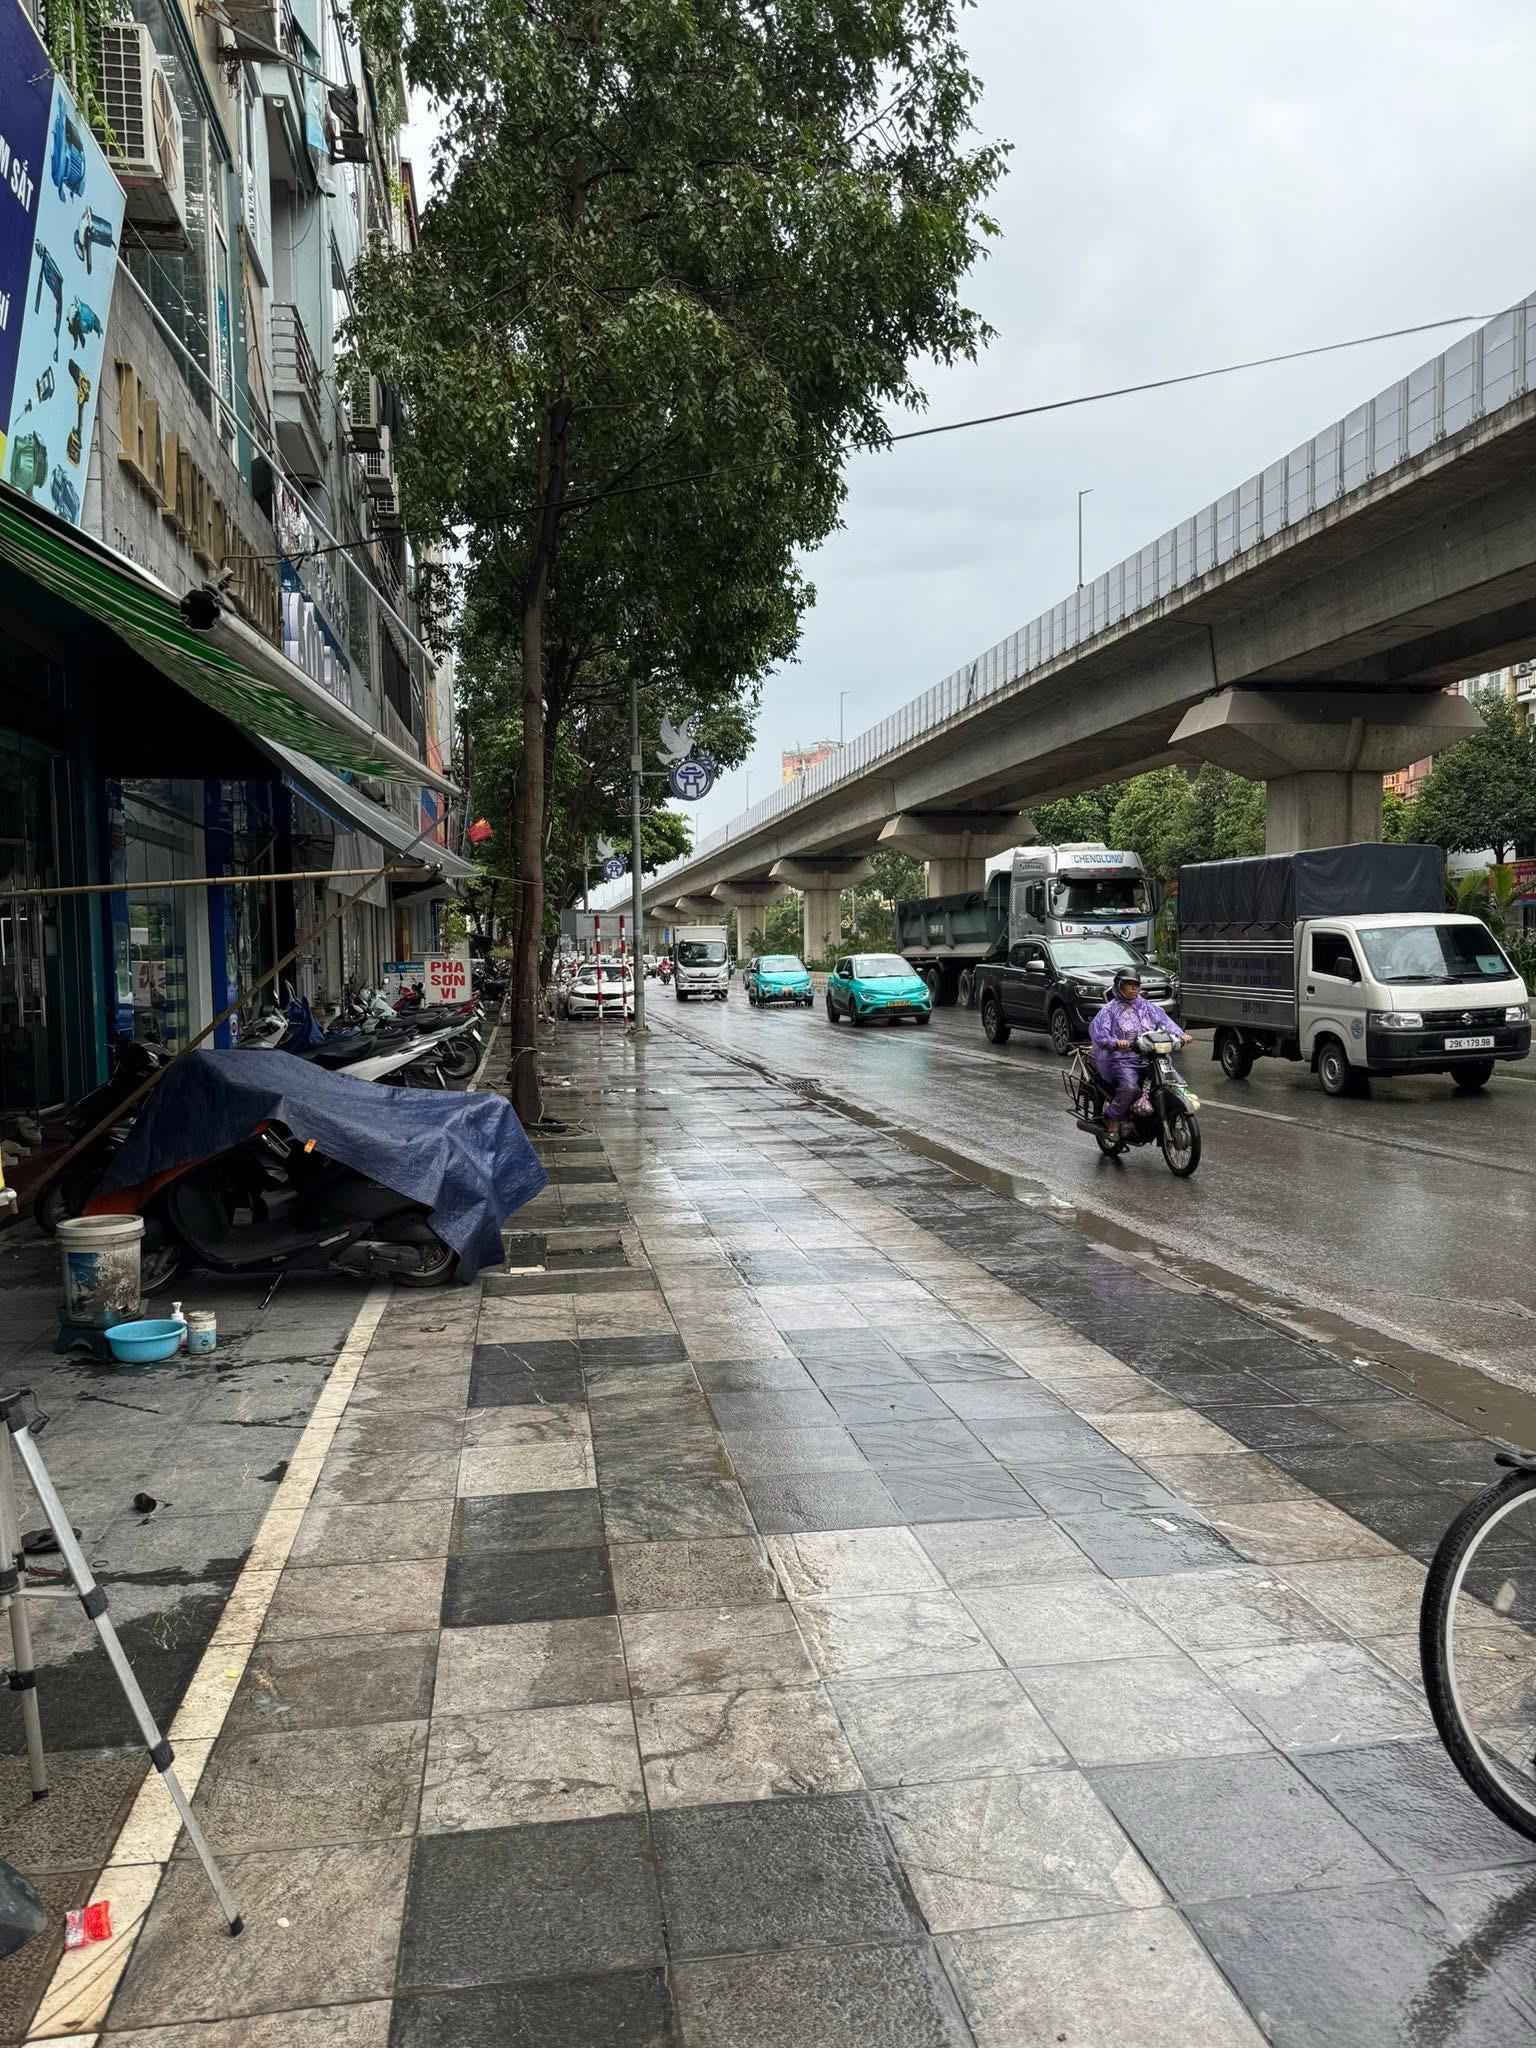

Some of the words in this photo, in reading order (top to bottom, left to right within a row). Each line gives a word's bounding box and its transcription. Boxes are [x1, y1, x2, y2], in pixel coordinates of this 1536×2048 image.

[10, 159, 34, 213] SẮT
[1073, 854, 1123, 864] CHENGLONG
[430, 961, 465, 973] PHA
[430, 974, 466, 986] SƠN
[440, 988, 457, 999] VI
